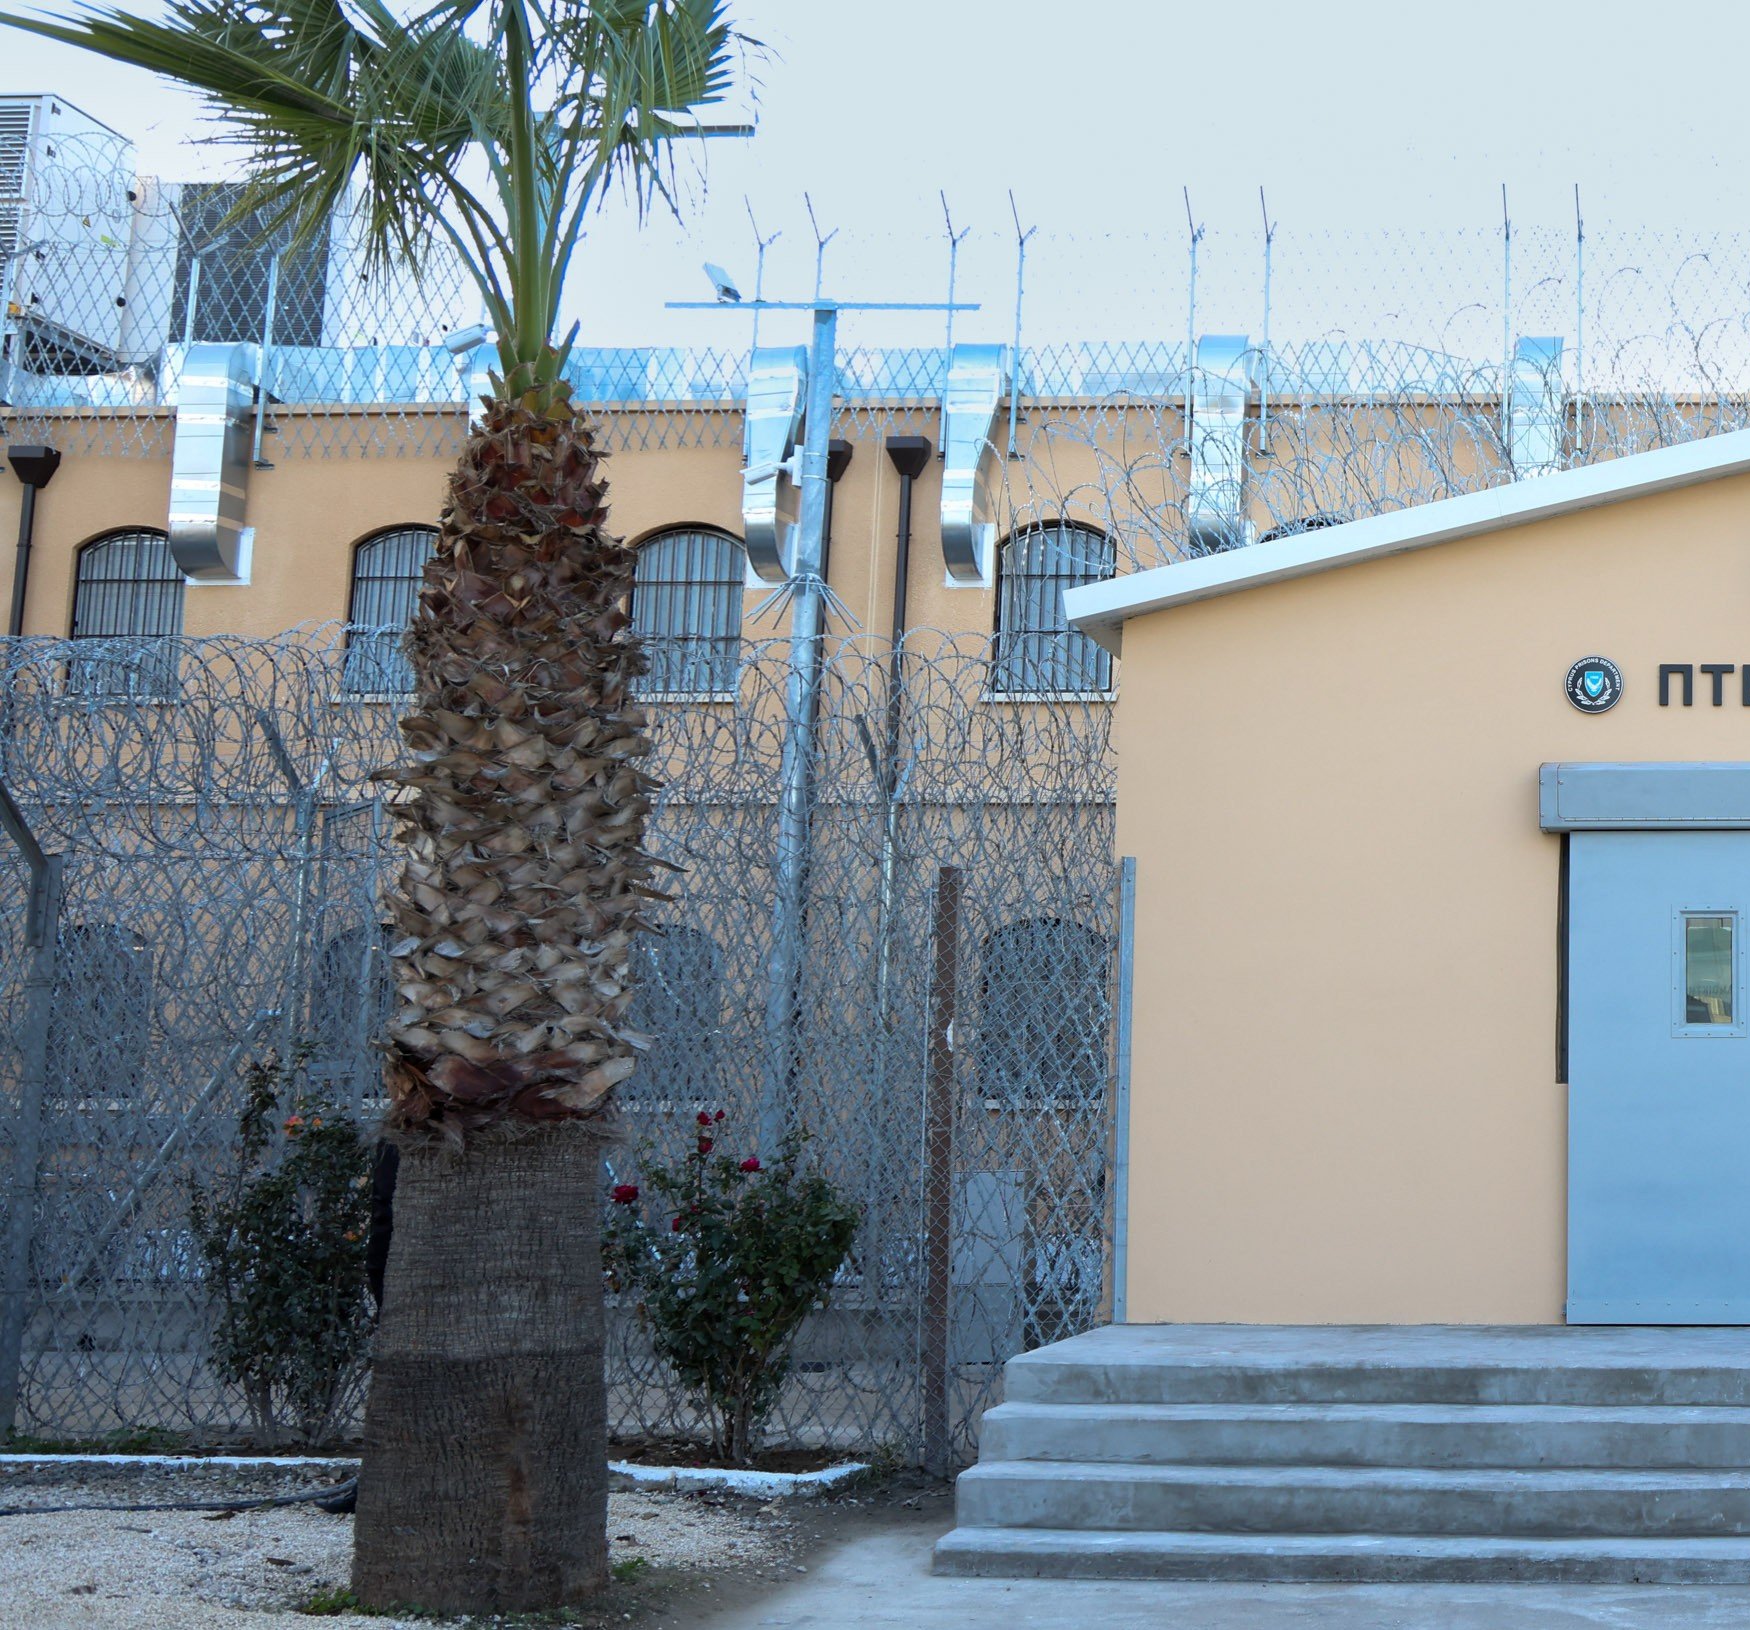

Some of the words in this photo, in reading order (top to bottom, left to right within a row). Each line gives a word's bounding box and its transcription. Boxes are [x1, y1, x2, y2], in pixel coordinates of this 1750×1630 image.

[1567, 669, 1577, 692] CYPRUS
[1574, 657, 1599, 670] PRISONS
[1599, 658, 1621, 691] DEPARTMENT
